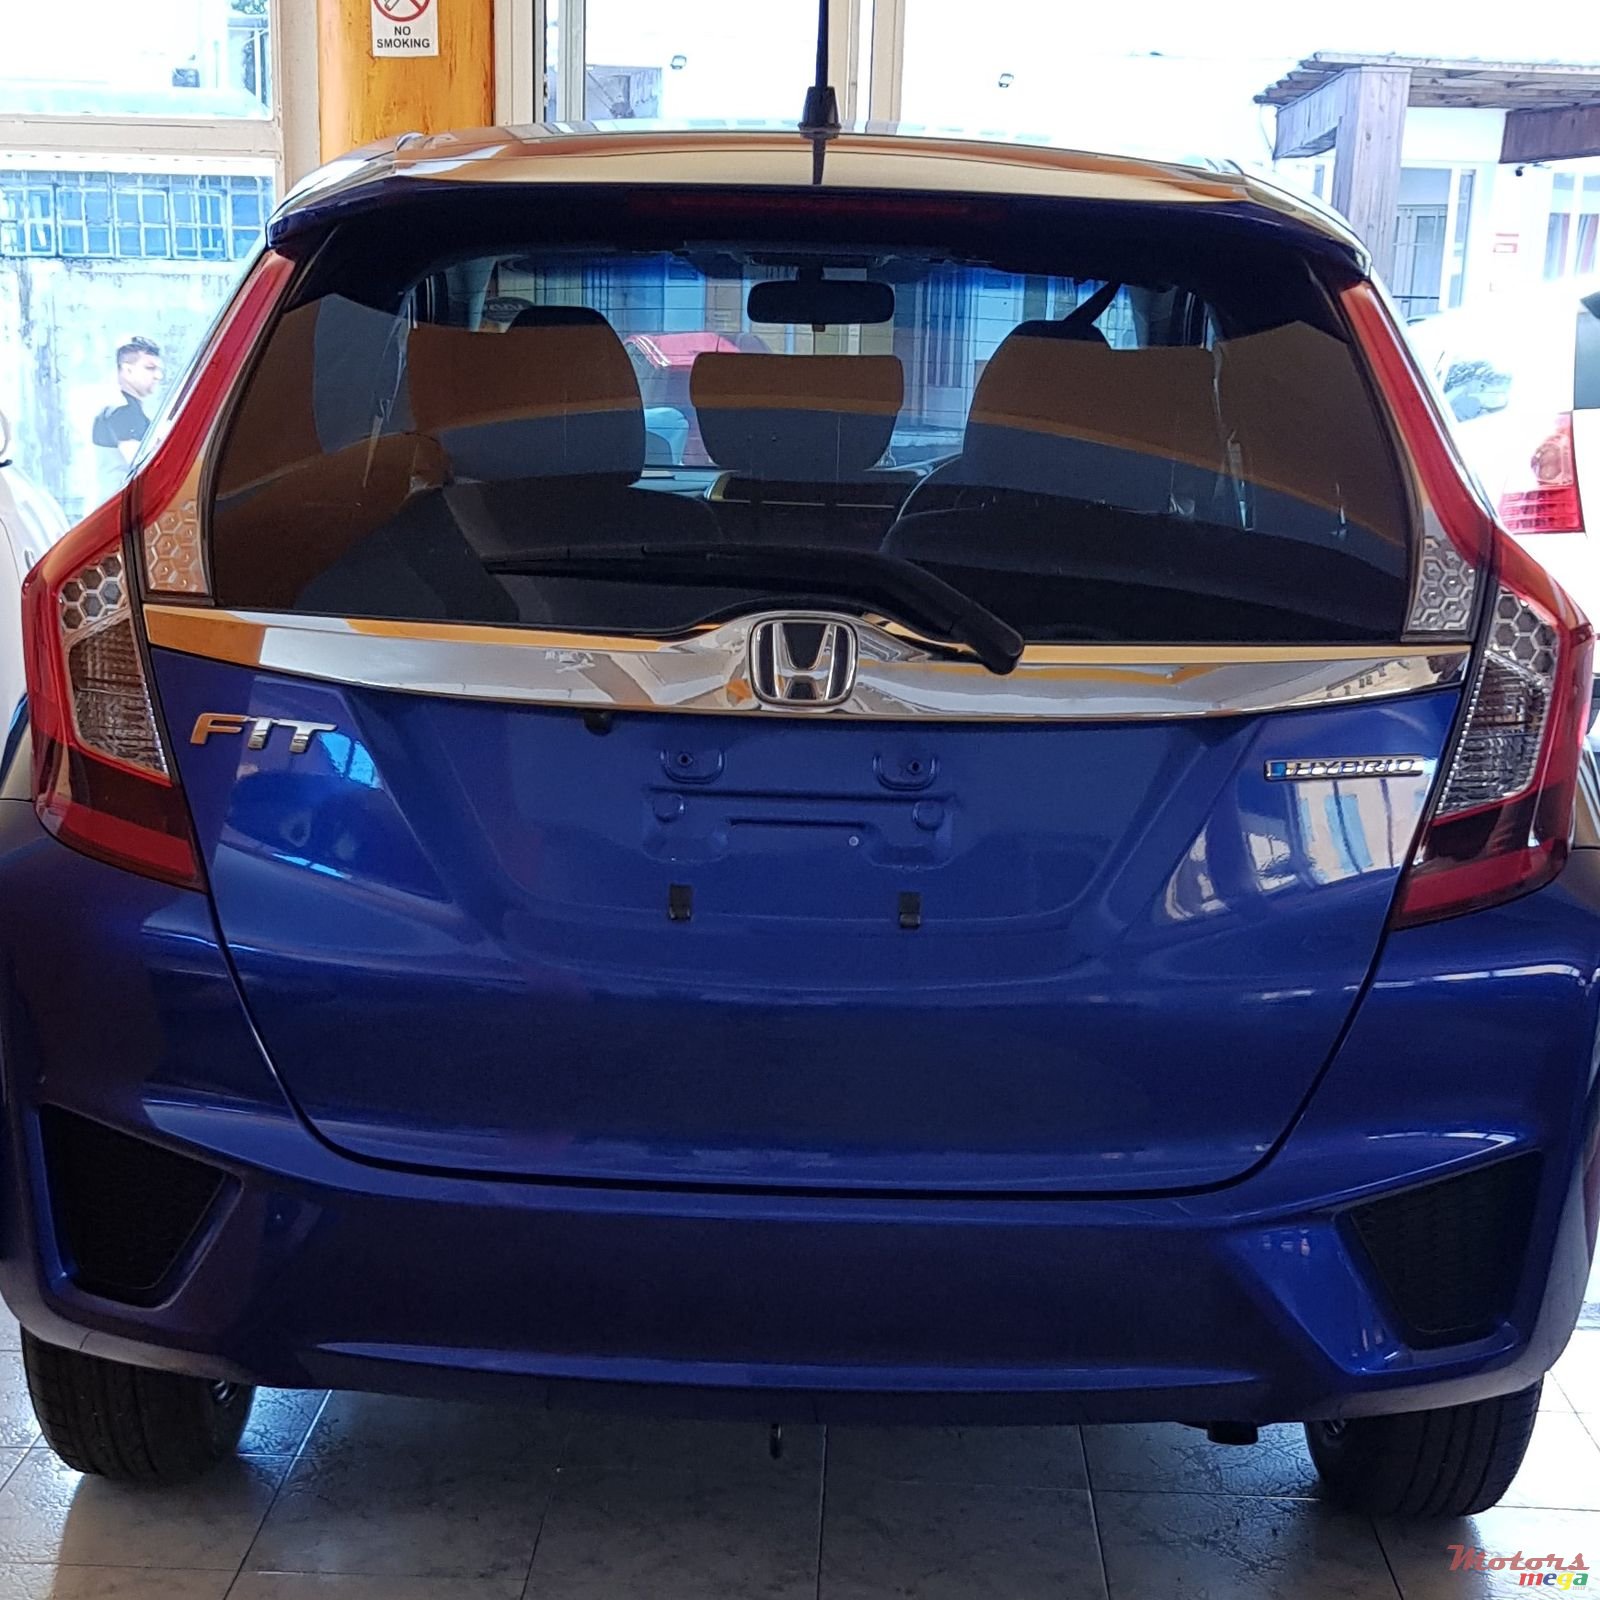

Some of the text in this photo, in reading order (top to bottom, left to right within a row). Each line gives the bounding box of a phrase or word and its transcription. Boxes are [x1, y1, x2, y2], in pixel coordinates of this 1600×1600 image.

[394, 26, 411, 36] NO
[376, 38, 431, 49] SMOKING
[190, 712, 338, 753] FIT
[1293, 759, 1415, 777] HYBRID
